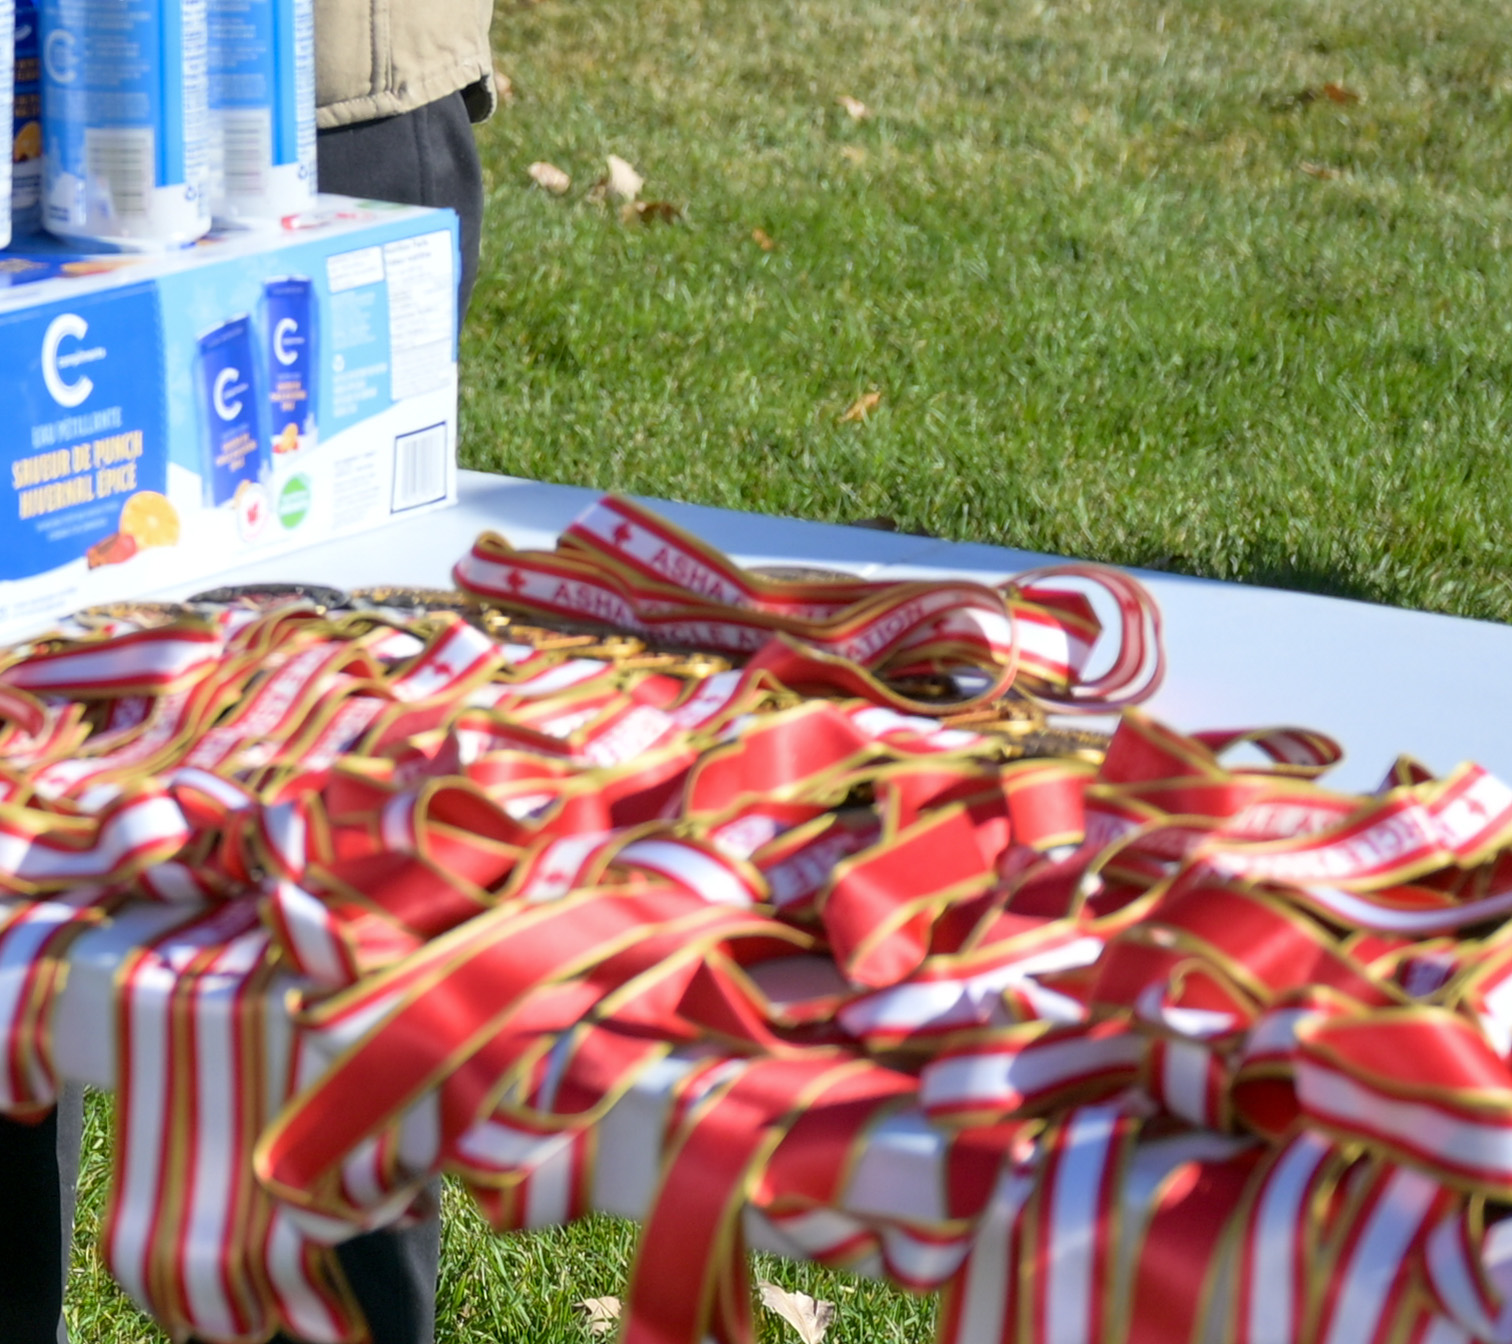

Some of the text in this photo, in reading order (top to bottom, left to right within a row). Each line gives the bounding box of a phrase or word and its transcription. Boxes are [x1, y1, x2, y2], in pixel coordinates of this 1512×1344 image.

[71, 442, 92, 474] DE
[92, 429, 144, 468] PUNCH
[651, 547, 725, 603] ASHA
